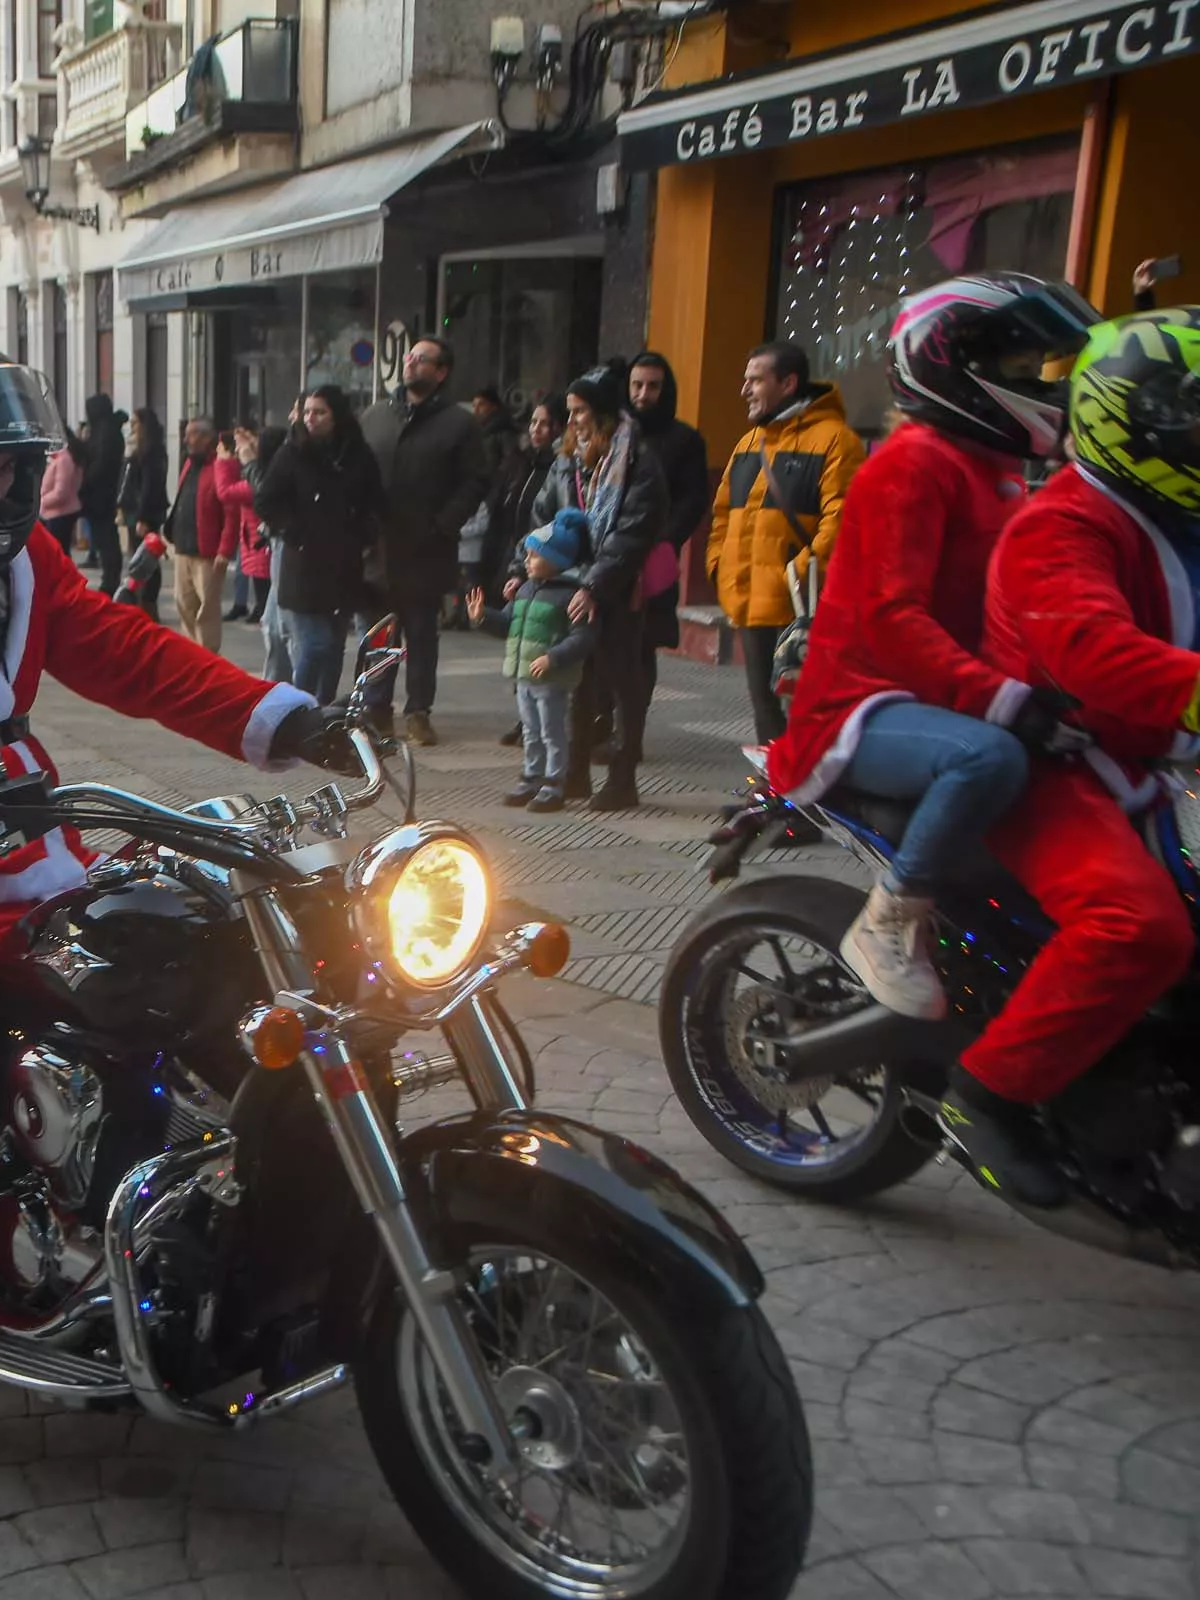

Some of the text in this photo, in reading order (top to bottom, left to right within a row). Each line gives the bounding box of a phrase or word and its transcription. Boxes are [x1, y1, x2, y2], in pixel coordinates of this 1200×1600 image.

[676, 0, 1200, 160] Café Bar LA OFICI
[156, 261, 192, 292] Café
[250, 249, 282, 278] Bar
